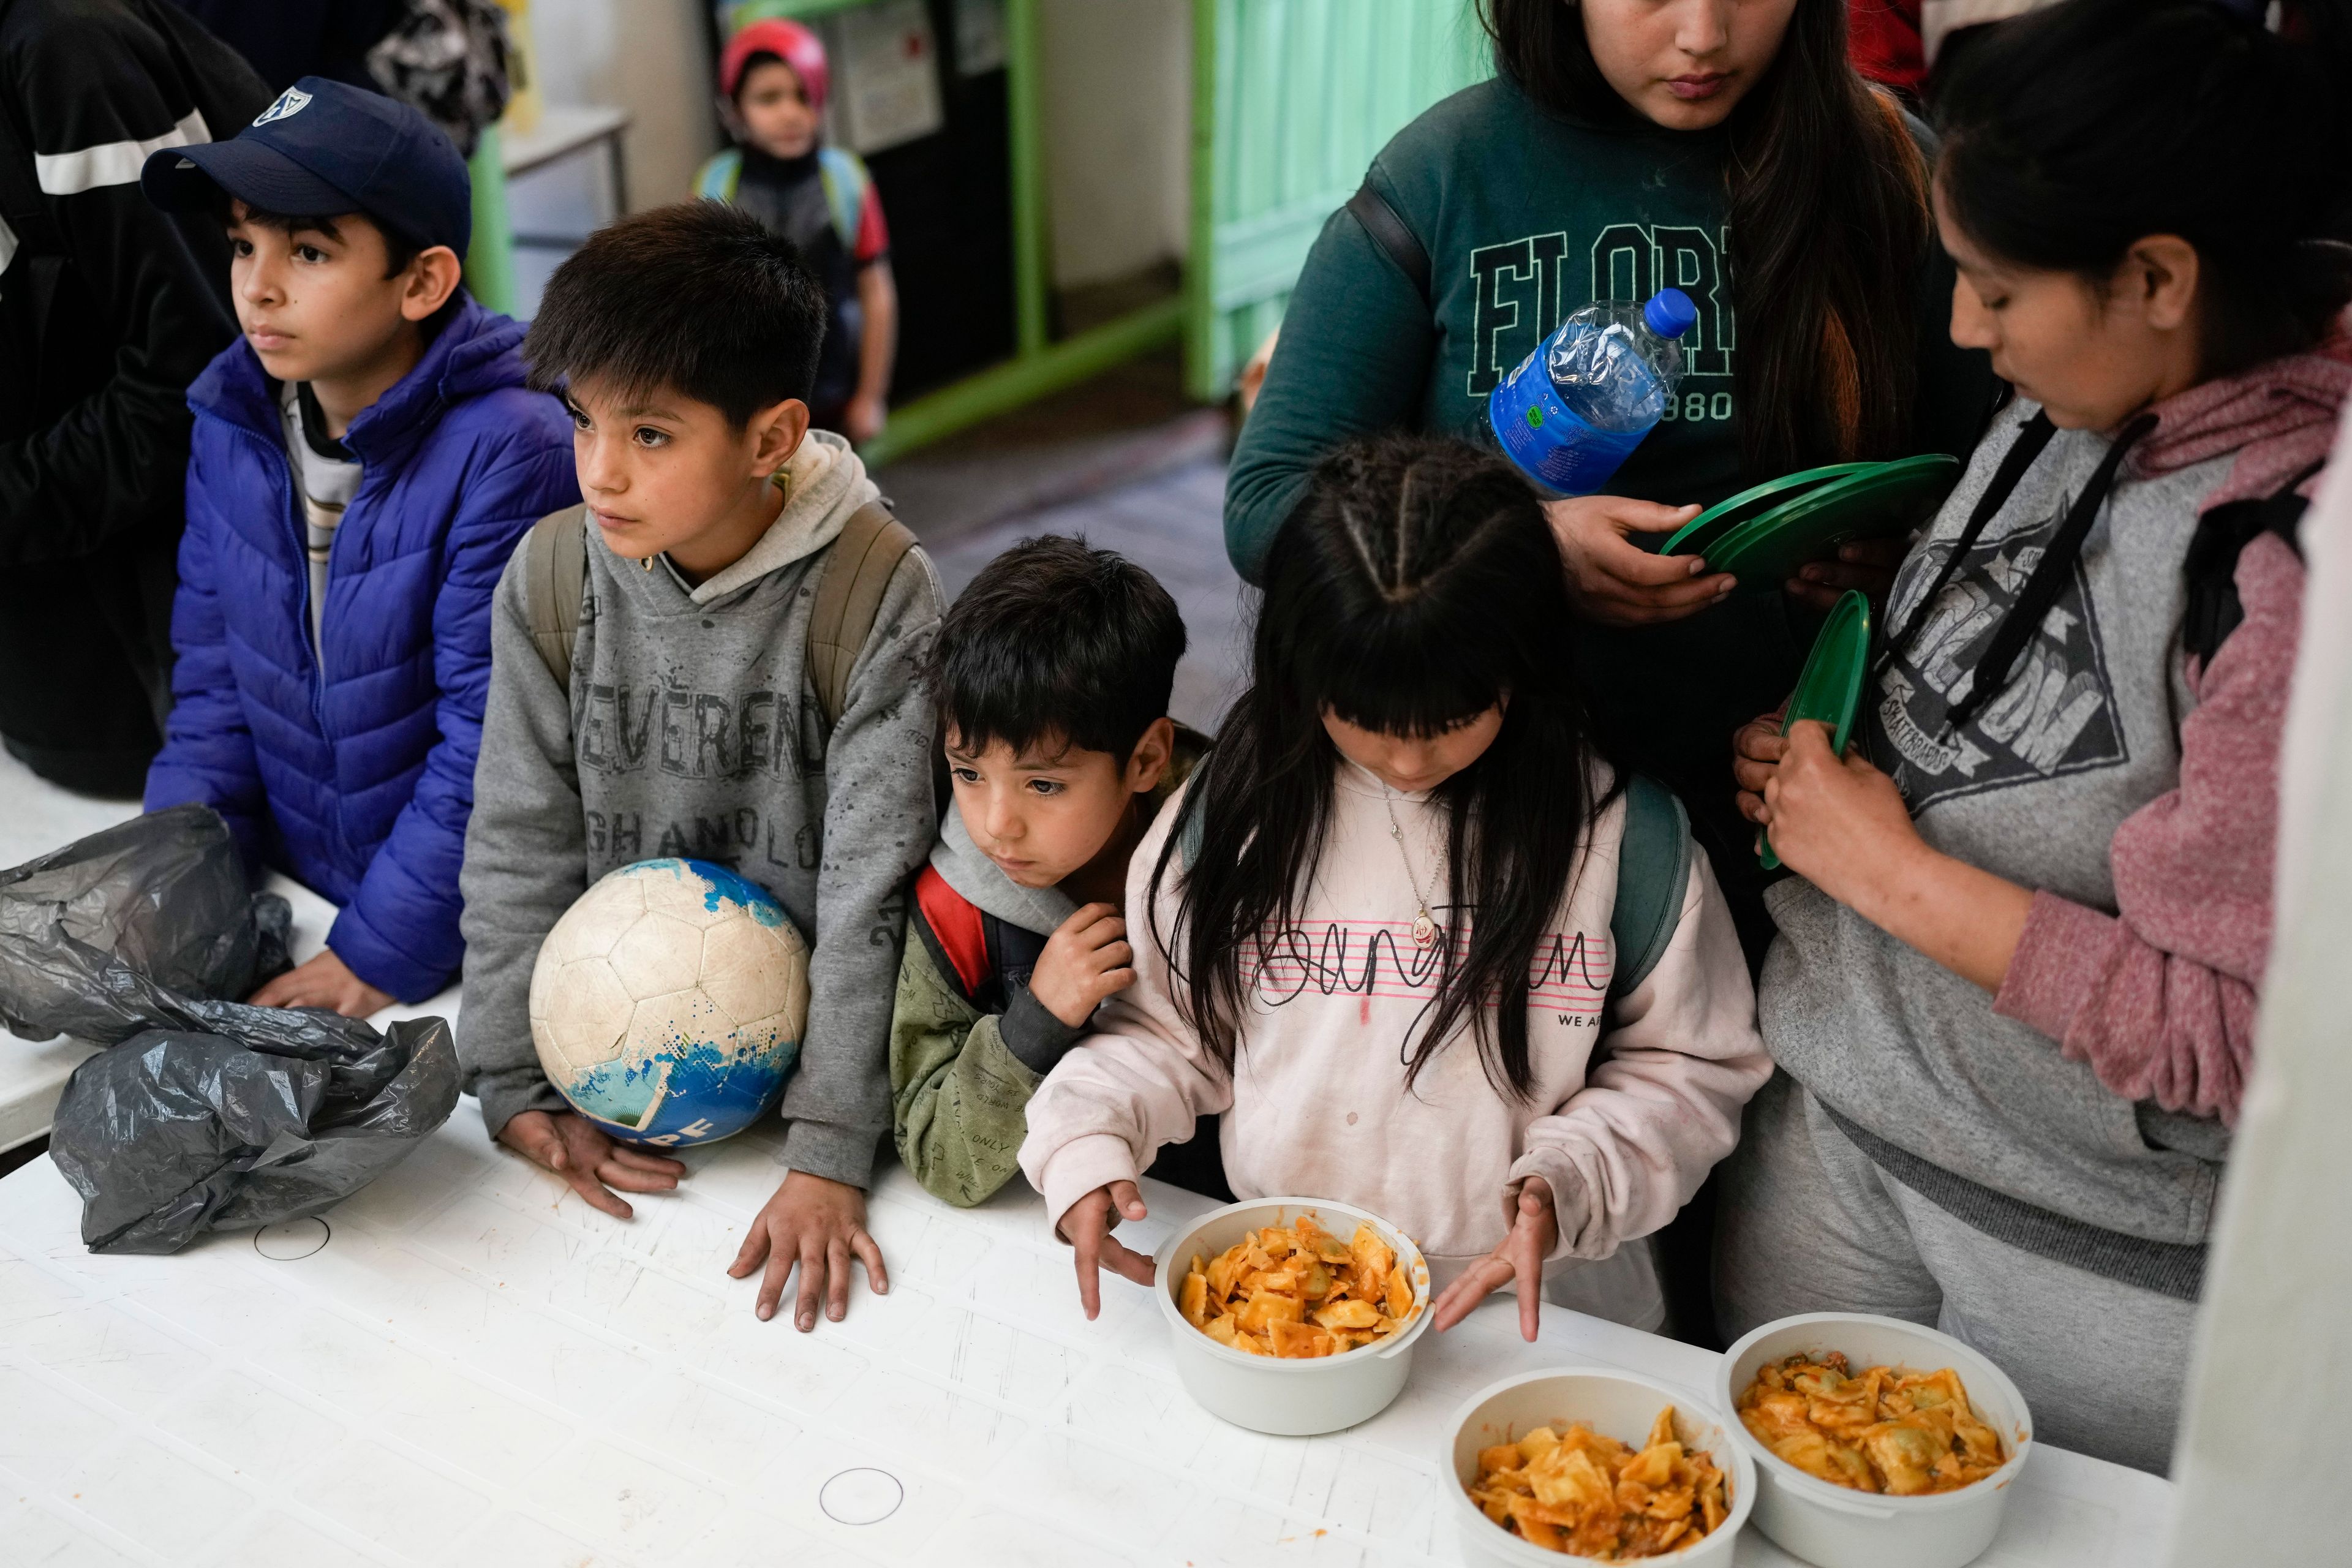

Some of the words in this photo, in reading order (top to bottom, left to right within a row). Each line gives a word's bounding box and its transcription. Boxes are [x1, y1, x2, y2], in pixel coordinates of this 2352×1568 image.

[1467, 224, 1736, 397] FLOR
[1882, 699, 1949, 771] SKATEBOARDS
[1558, 1014, 1582, 1027] WE
[973, 1073, 1000, 1093] YOURS
[972, 1134, 1010, 1153] ONLY
